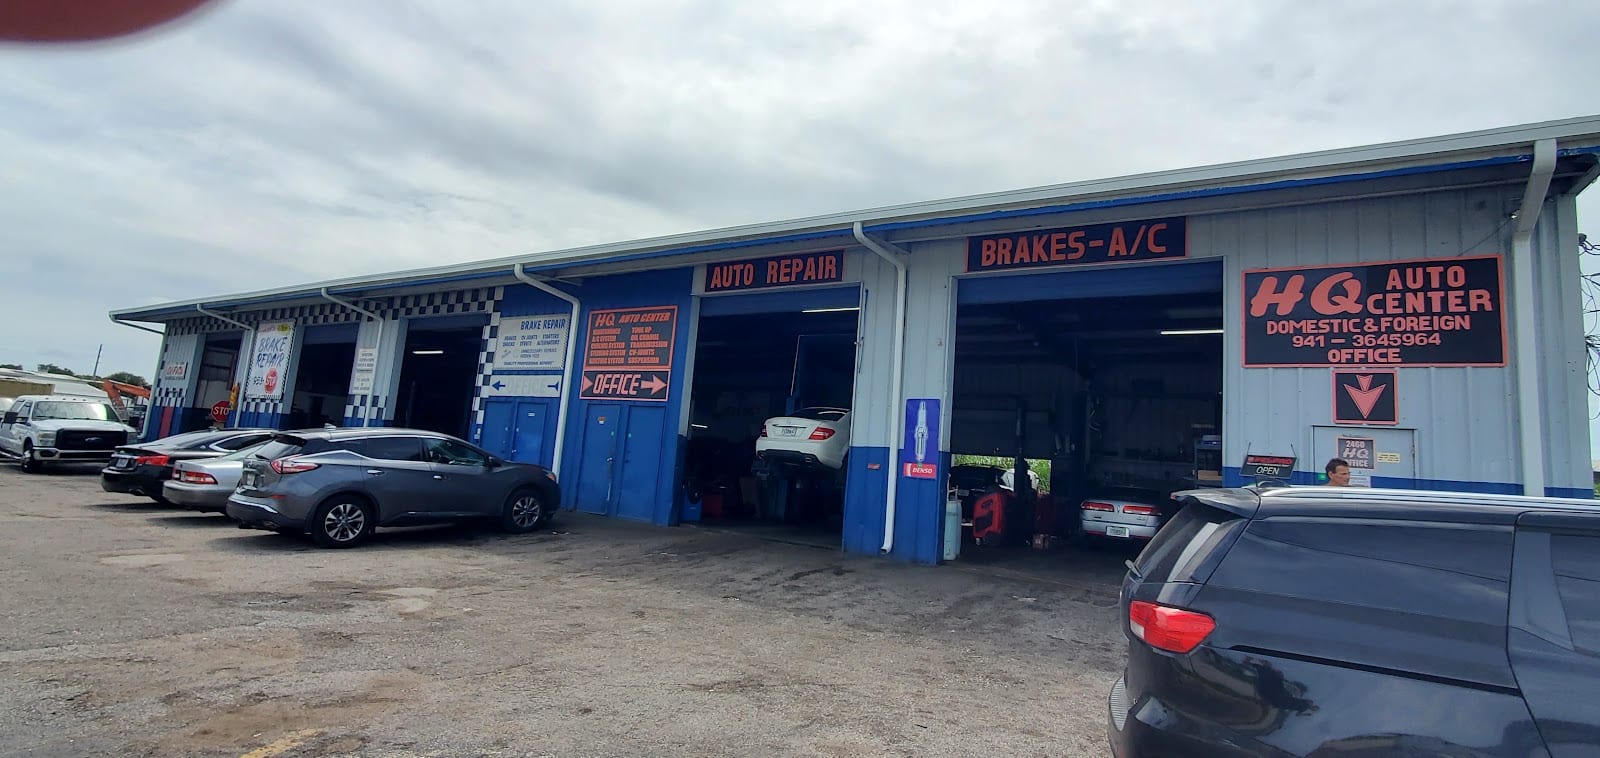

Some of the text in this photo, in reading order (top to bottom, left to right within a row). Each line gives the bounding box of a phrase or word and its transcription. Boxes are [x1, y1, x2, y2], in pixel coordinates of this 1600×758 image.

[981, 223, 1167, 266] BRAKES-A/C
[710, 256, 837, 288] AUTO REPAIR
[1386, 265, 1466, 290] AUTO
[1250, 272, 1363, 317] HQ
[1366, 289, 1493, 315] CENTER
[521, 319, 566, 330] BRAKE REPAIR
[595, 312, 671, 327] HQ AUTO CENTER
[1266, 318, 1361, 335] DOMESTIC
[1380, 315, 1471, 332] FOREIGN
[259, 336, 288, 352] BRAKE
[1292, 336, 1325, 348] 941
[1352, 333, 1441, 347] 3645964
[256, 353, 285, 368] REPAIR
[1328, 348, 1402, 363] OFFICE
[593, 374, 641, 395] OFFICE
[1342, 448, 1369, 459] HQ
[1256, 466, 1280, 475] OPEN
